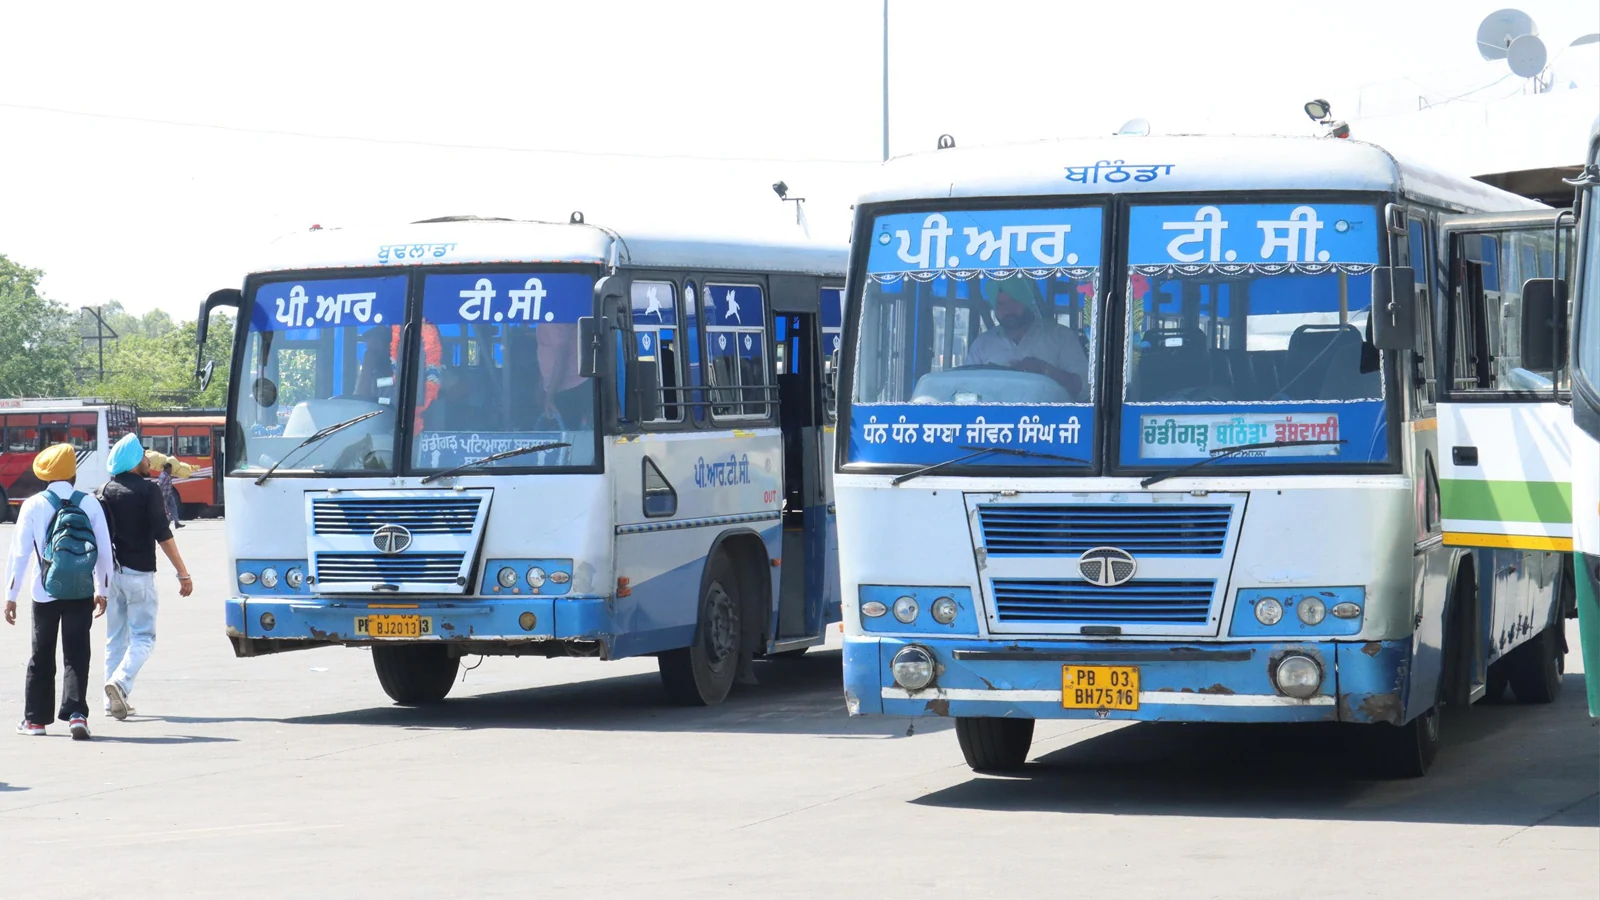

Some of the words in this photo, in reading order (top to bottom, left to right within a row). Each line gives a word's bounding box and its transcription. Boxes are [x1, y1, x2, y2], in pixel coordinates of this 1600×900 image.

[1064, 159, 1175, 184] ਬਠਿੰਡਾ
[863, 415, 889, 443] ਧੰਨ
[892, 415, 919, 443] ਧੰਨ
[922, 423, 962, 443] ਬਾਬਾ
[966, 416, 1014, 443] ਜੀਵਨ
[1017, 415, 1056, 443] ਸਿੰਘ
[1059, 415, 1081, 443] ਜੀ
[763, 490, 777, 503] OUT
[377, 622, 417, 634] BJ2013
[1077, 669, 1095, 686] PB
[1110, 670, 1129, 687] 03
[1075, 688, 1133, 705] BH7516
